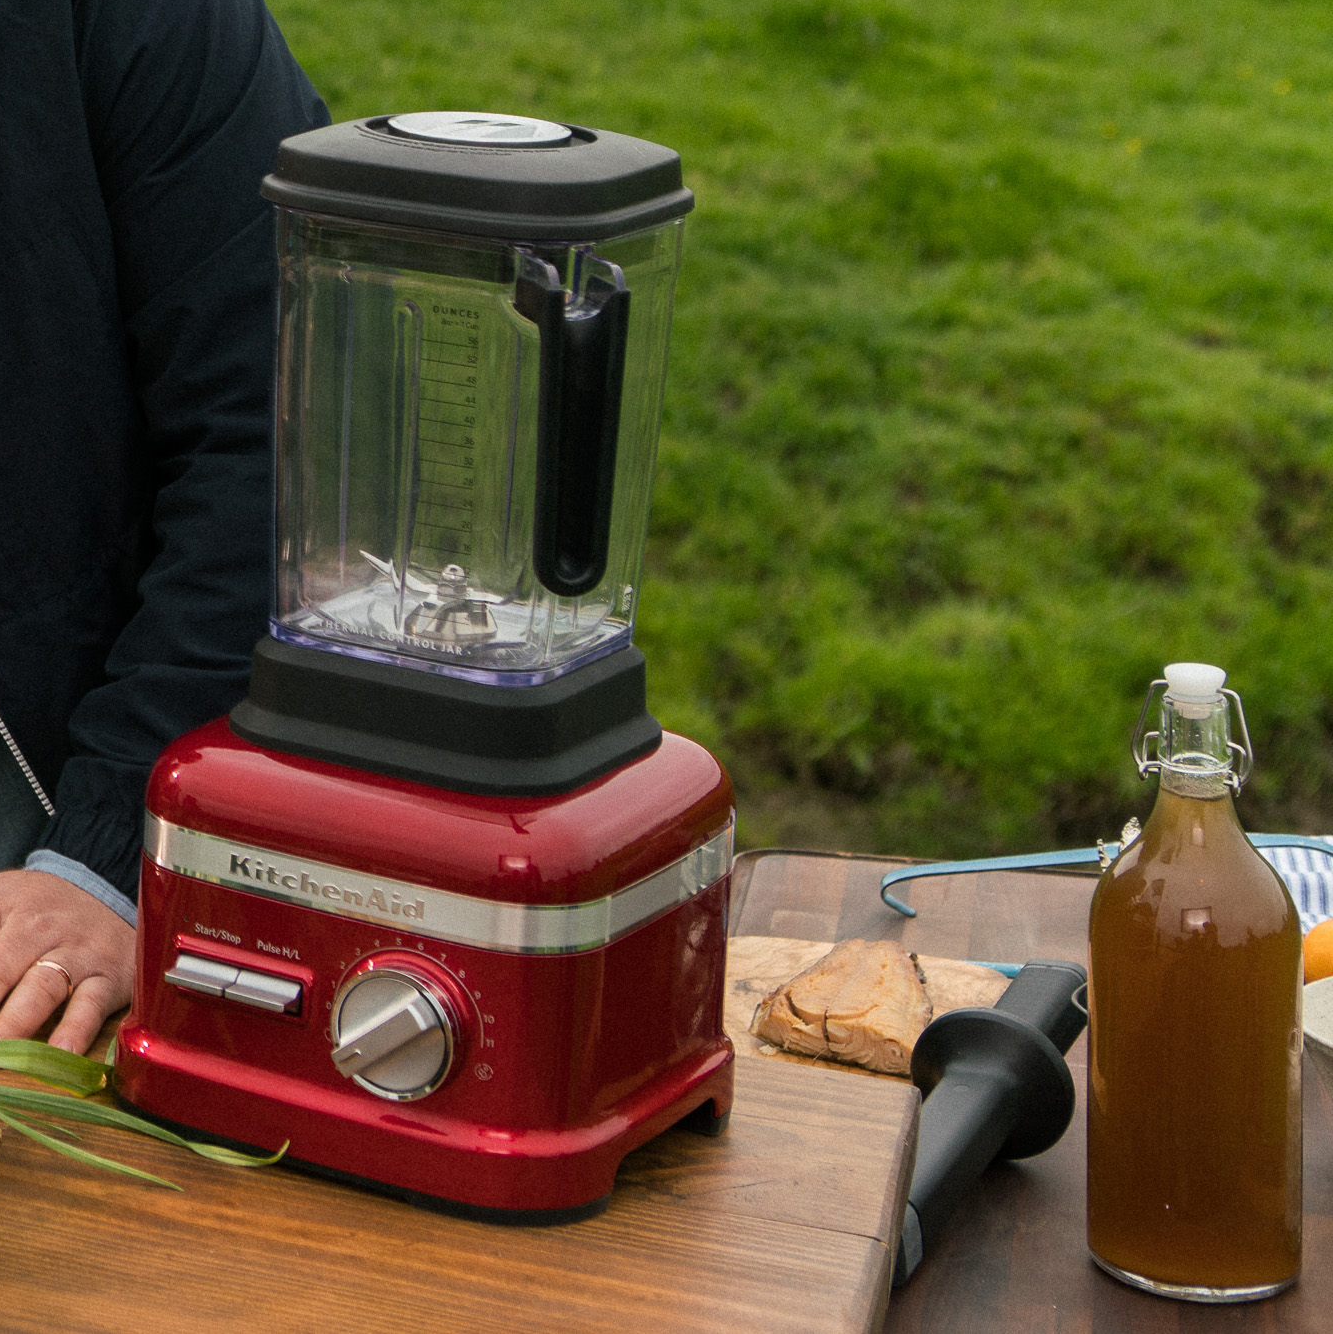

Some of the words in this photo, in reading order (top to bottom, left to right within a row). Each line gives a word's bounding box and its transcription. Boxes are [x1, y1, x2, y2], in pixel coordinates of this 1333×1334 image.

[433, 305, 480, 320] OUNCES
[462, 520, 473, 530] 20
[319, 620, 375, 639] THERMAL
[380, 630, 437, 651] CONTROL
[440, 643, 463, 656] JAR
[228, 852, 426, 921] KitchenAid
[194, 923, 242, 945] Start/Stop
[396, 938, 402, 946] 5
[256, 939, 281, 955] Pulse
[282, 946, 301, 961] H/L
[418, 943, 425, 951] 6
[355, 948, 361, 956] 3
[440, 953, 447, 962] 7
[459, 970, 466, 978] 8
[474, 991, 481, 999] 9
[484, 1015, 495, 1024] 10
[486, 1039, 495, 1048] 11
